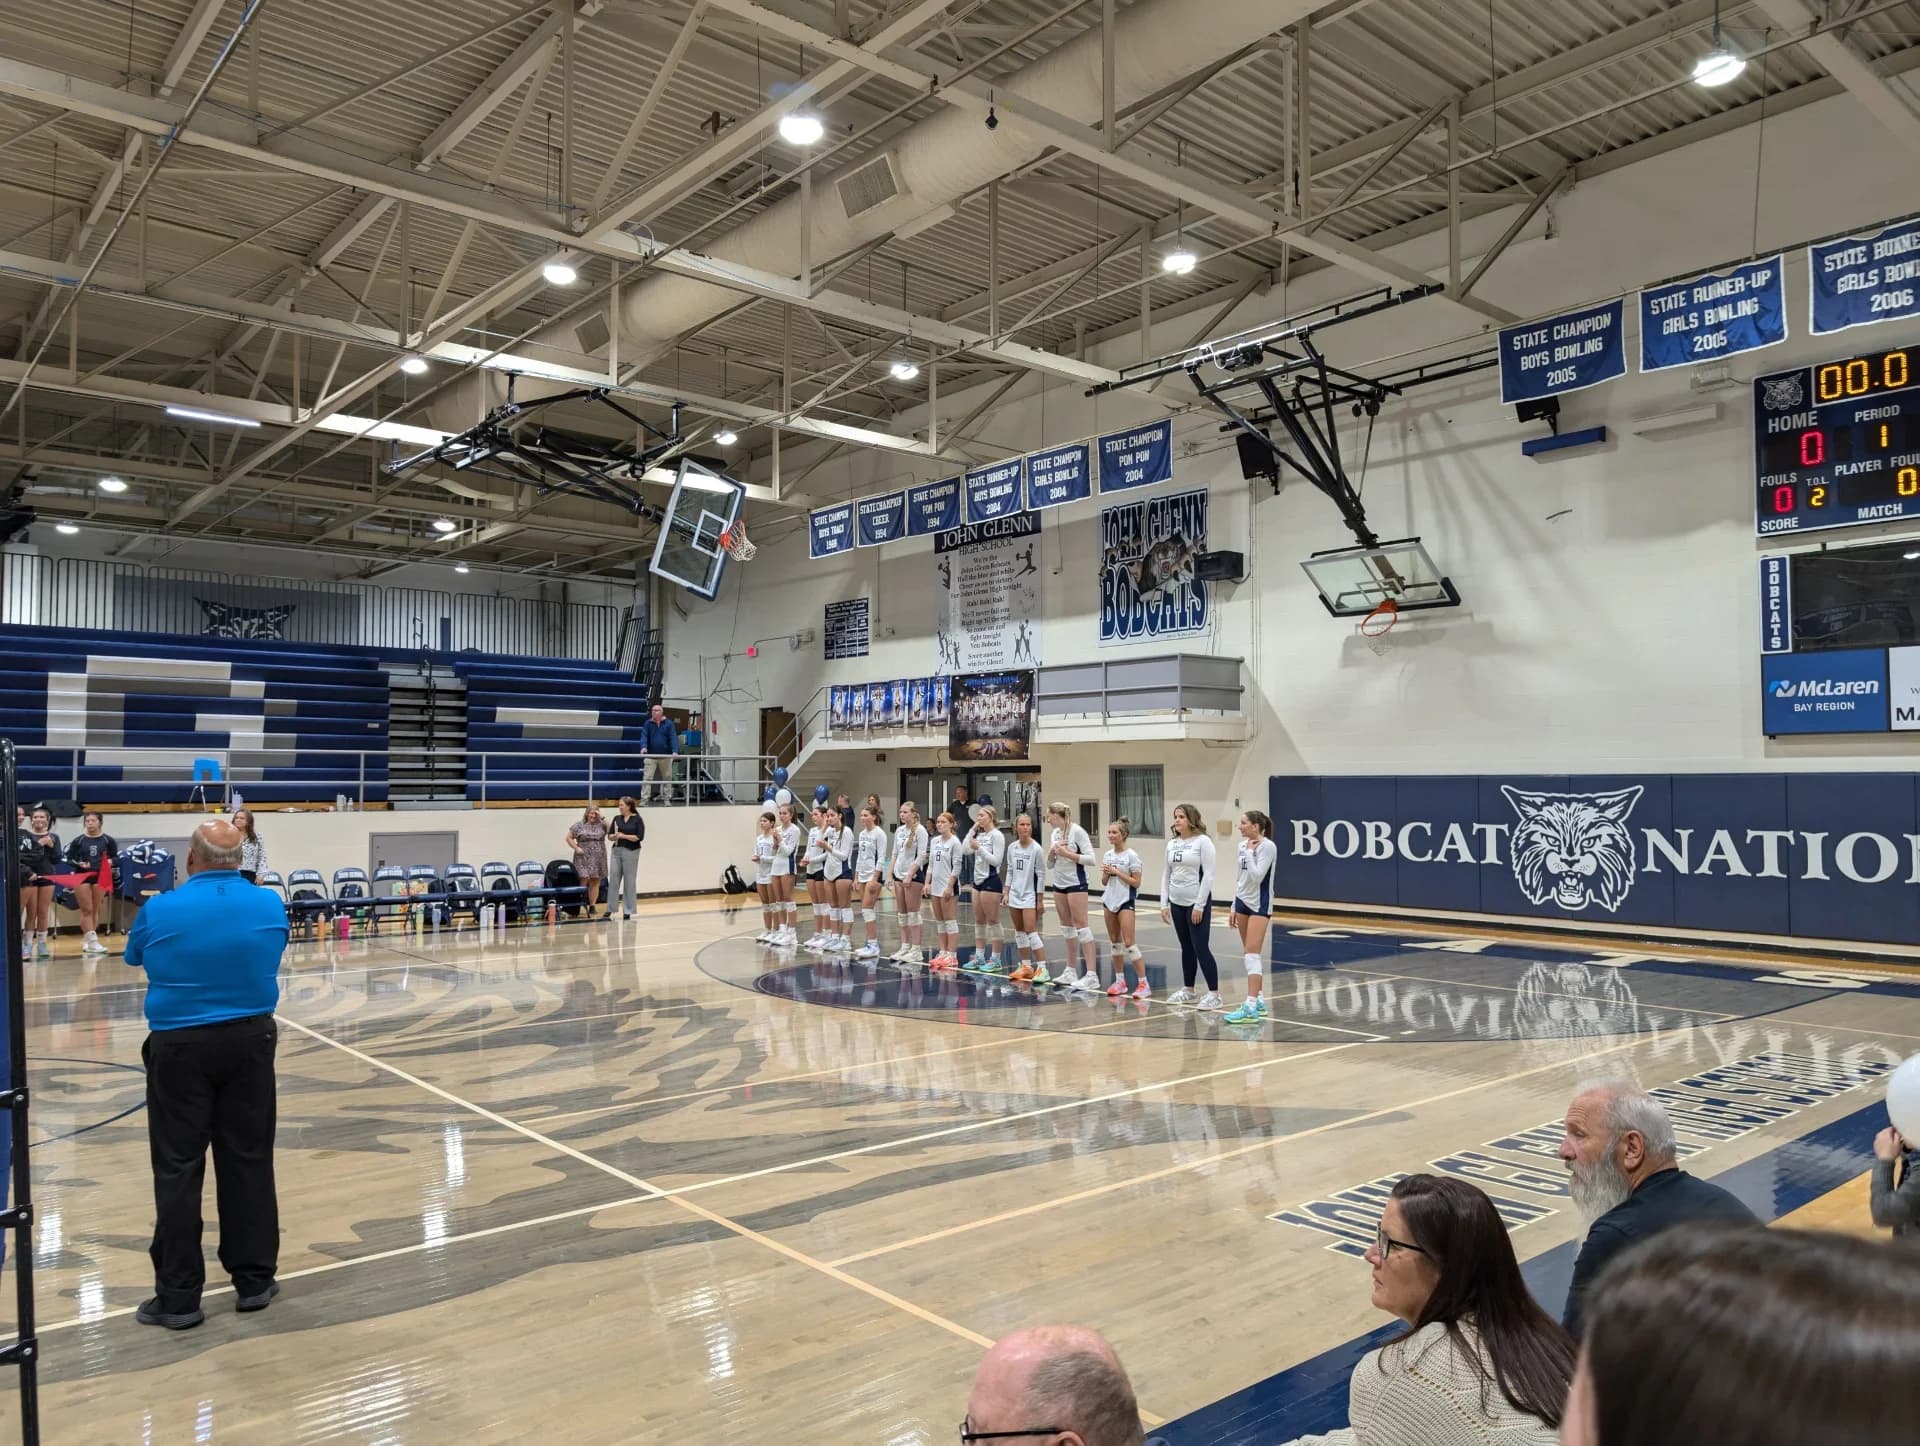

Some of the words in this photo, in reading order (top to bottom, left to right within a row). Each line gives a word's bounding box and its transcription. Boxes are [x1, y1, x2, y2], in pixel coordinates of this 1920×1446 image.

[1824, 245, 1867, 272] STATE
[1837, 268, 1879, 294] GIRLS
[1651, 290, 1687, 315] STATE
[1870, 288, 1914, 312] 2006
[1513, 329, 1549, 350] STATE
[1553, 312, 1612, 340] CHAMPION
[1662, 312, 1699, 335] GIRLS
[1693, 329, 1727, 352] 2005
[1520, 351, 1550, 371] BOYS
[1554, 337, 1603, 363] BOWLING
[1546, 365, 1576, 387] 2005
[1768, 410, 1819, 433] HOME
[1854, 404, 1900, 423] PERIOD
[1105, 439, 1127, 453] STATE
[1129, 428, 1163, 448] CHAMPION
[1880, 425, 1888, 448] 1
[1801, 431, 1824, 466] 0
[1032, 457, 1052, 471] STATE
[1125, 468, 1143, 483] 2004
[1834, 459, 1882, 477] PLAYER
[1034, 473, 1053, 487] GIRLS
[1760, 472, 1798, 487] FOULS
[1050, 485, 1067, 500] 2004
[1774, 486, 1793, 513] 0
[1810, 487, 1825, 506] 2
[1857, 503, 1902, 520] MATCH
[942, 524, 978, 549] JOHN
[983, 515, 1033, 537] GLENN
[1102, 501, 1145, 565] JOHN
[1146, 488, 1208, 550] GLENN
[1761, 517, 1799, 532] SCORE
[959, 544, 979, 556] HIGH
[981, 536, 1013, 552] SCHOOL
[1100, 563, 1209, 640] BOBCATS
[1769, 560, 1782, 649] BOBCATS
[1798, 679, 1879, 697] McLaren
[1794, 703, 1812, 712] BAY
[1816, 701, 1855, 712] REGION
[1290, 819, 1509, 865] BOBCAT
[1172, 850, 1184, 863] 15
